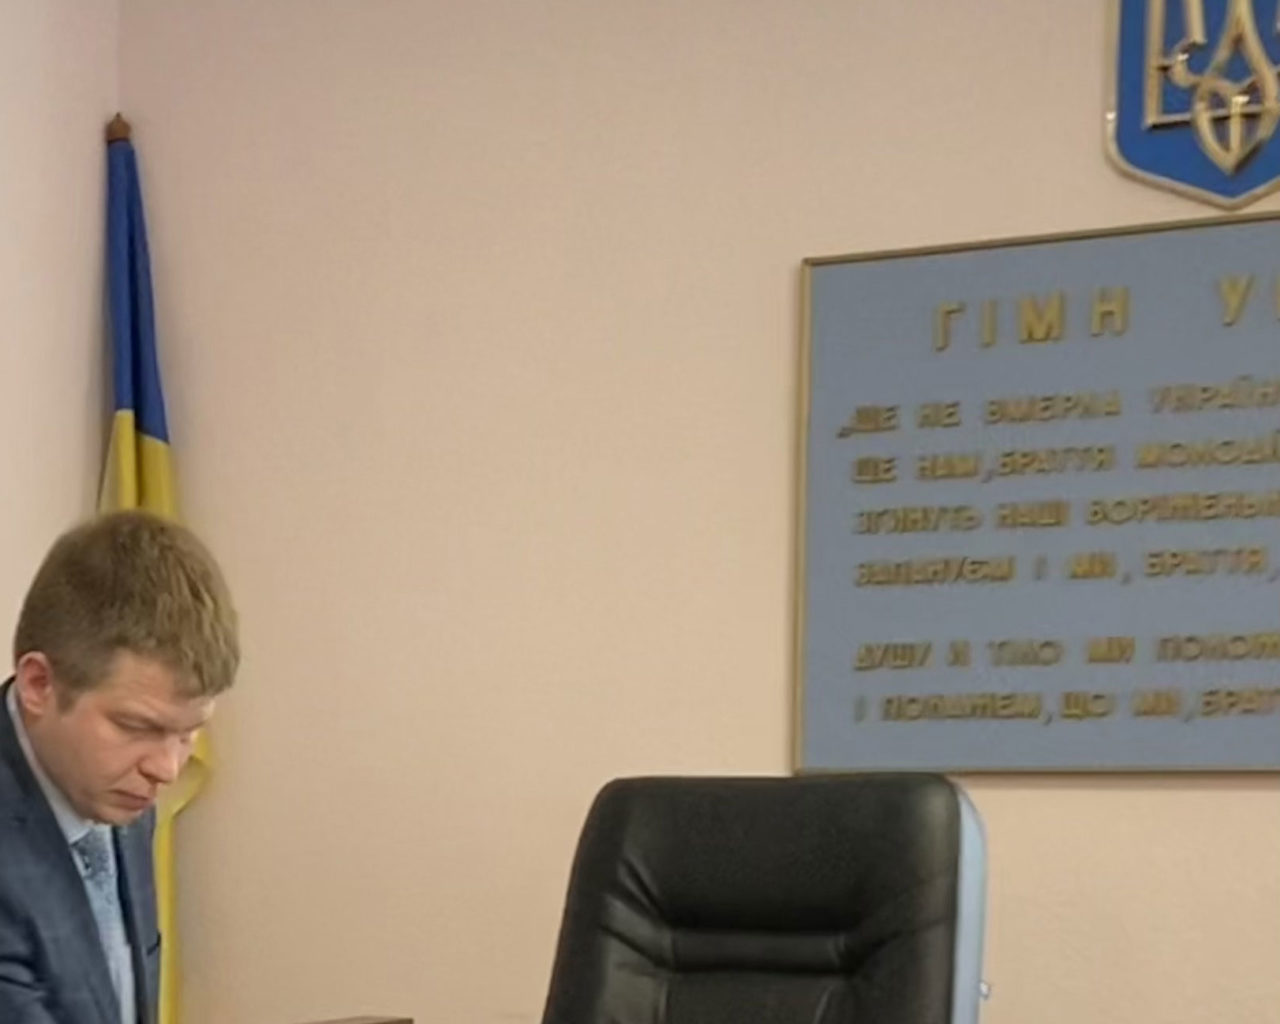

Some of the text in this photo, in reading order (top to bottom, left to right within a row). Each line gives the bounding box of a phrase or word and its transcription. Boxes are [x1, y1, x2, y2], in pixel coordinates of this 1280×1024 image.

[931, 273, 1280, 352] ГІМН У
[918, 402, 962, 428] НЕ
[985, 390, 1122, 425] ВМЕРЛА
[852, 456, 898, 484] ЩЕ
[852, 505, 983, 535] ЗГИНУТЬ
[1033, 555, 1047, 582] І
[853, 642, 933, 672] ДУШУ
[1086, 636, 1136, 665] МИ
